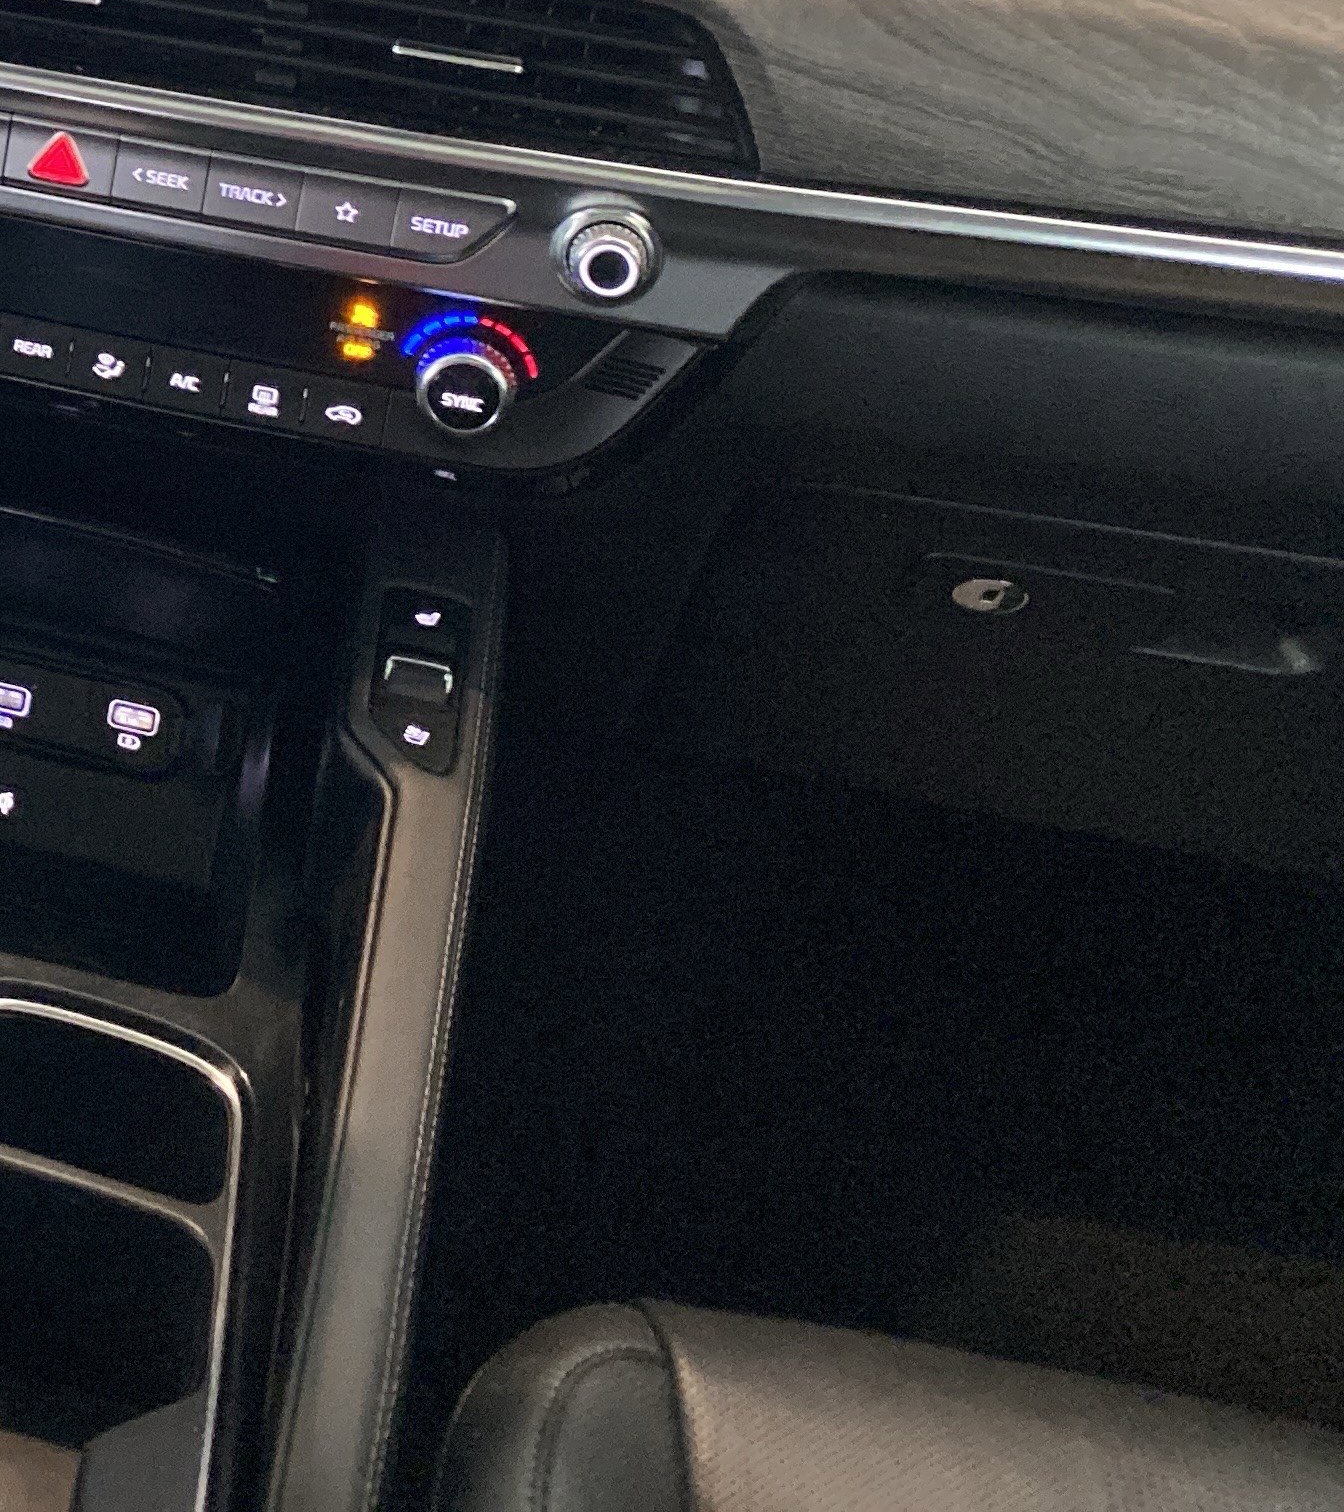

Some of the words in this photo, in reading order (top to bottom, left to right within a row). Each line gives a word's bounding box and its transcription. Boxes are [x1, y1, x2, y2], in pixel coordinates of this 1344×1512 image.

[145, 169, 189, 191] SEEK
[218, 182, 273, 207] TRACK
[410, 216, 470, 239] SETUP
[13, 338, 53, 360] REAR
[169, 371, 201, 393] A/C
[441, 392, 485, 414] SYNC
